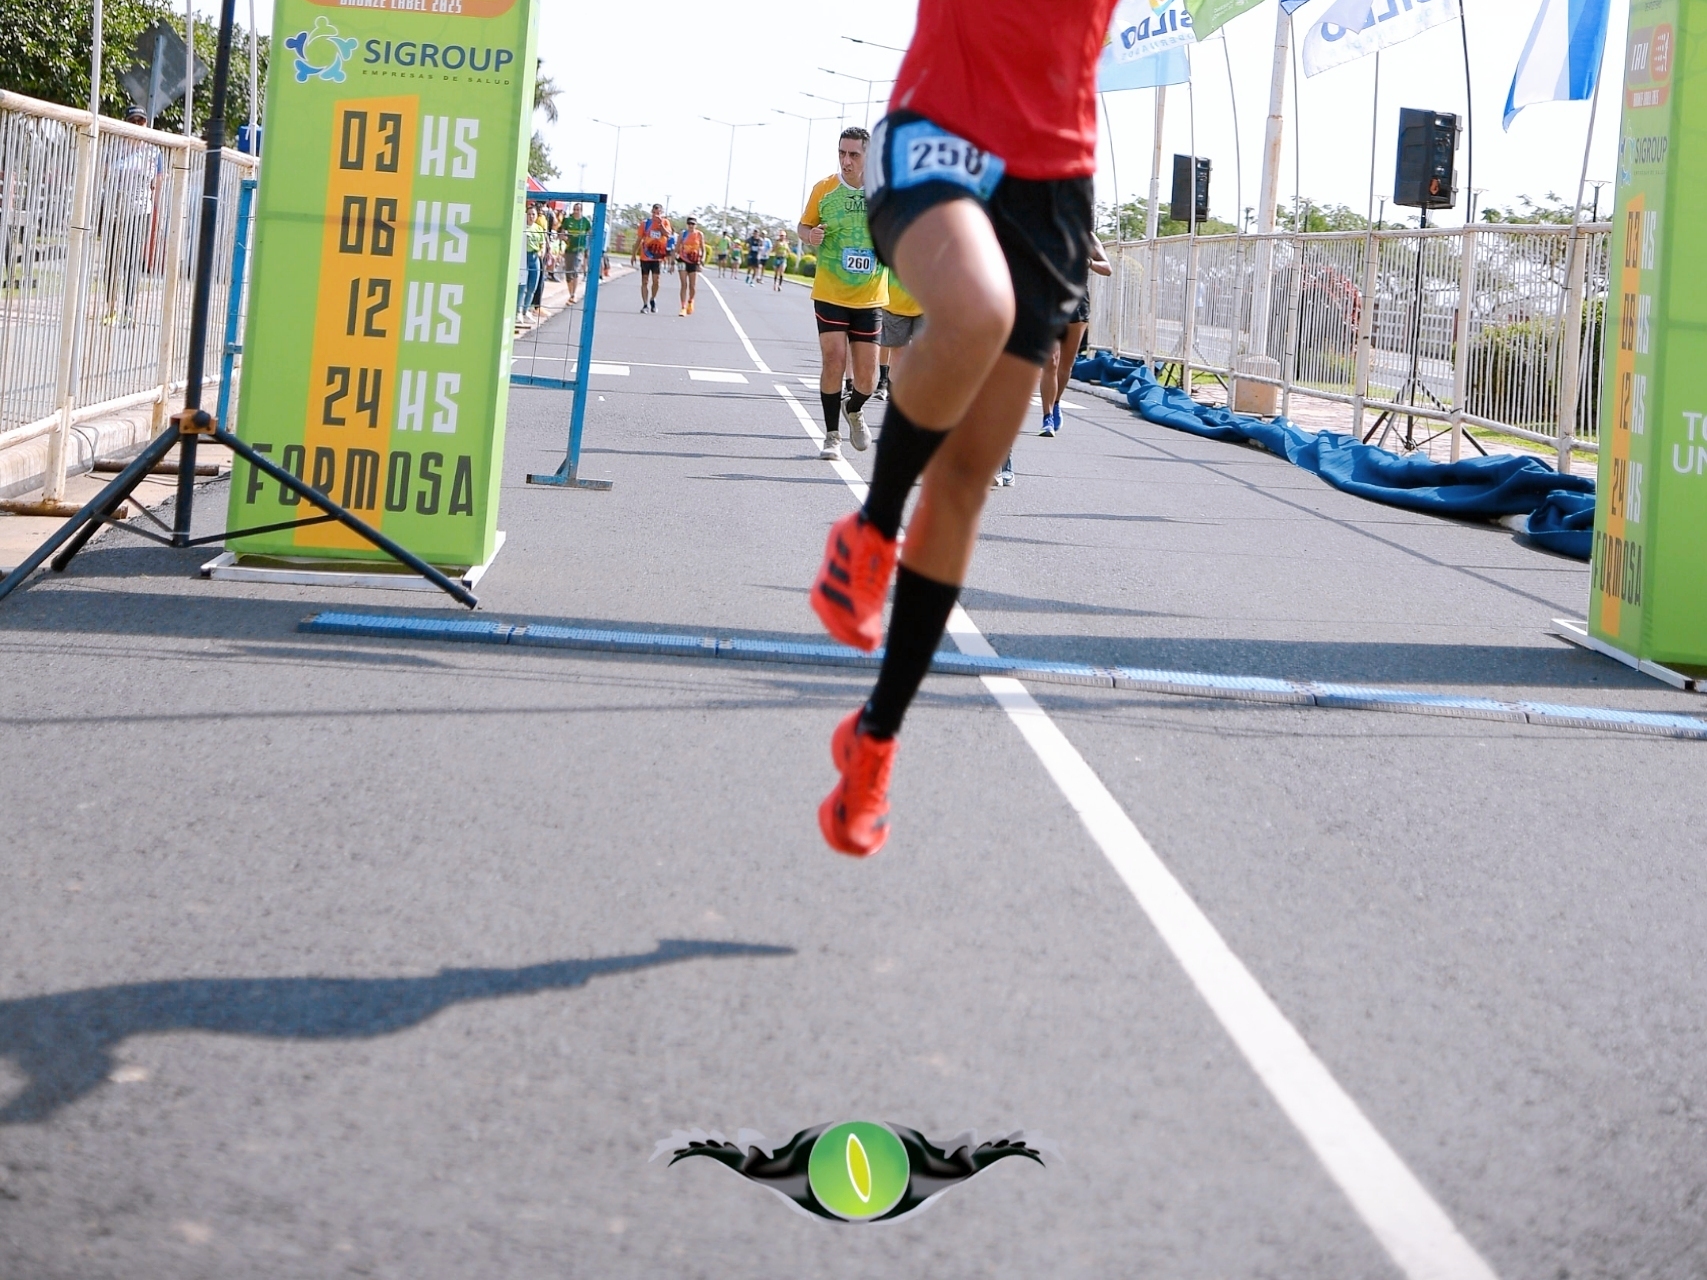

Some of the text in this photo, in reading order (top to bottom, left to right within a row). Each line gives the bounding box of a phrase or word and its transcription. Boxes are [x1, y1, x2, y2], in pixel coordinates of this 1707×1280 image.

[362, 69, 433, 80] EMPRESAS
[467, 76, 510, 86] SALUD
[363, 39, 514, 73] SIGROUP
[1631, 42, 1649, 72] IAU
[339, 110, 480, 179] 03 HS
[1634, 135, 1668, 164] SIGROUP
[339, 195, 471, 263] 06 HS
[1625, 210, 1657, 270] 03 HS
[847, 256, 870, 270] 260
[346, 277, 464, 345] 12 HS
[1621, 292, 1651, 355] 06 HS
[322, 365, 461, 434] 24 HS
[1619, 372, 1647, 435] 12 HS
[246, 442, 473, 517] FORMOSA
[1611, 458, 1643, 524] 24 HS
[1593, 531, 1643, 607] FORMOSA
